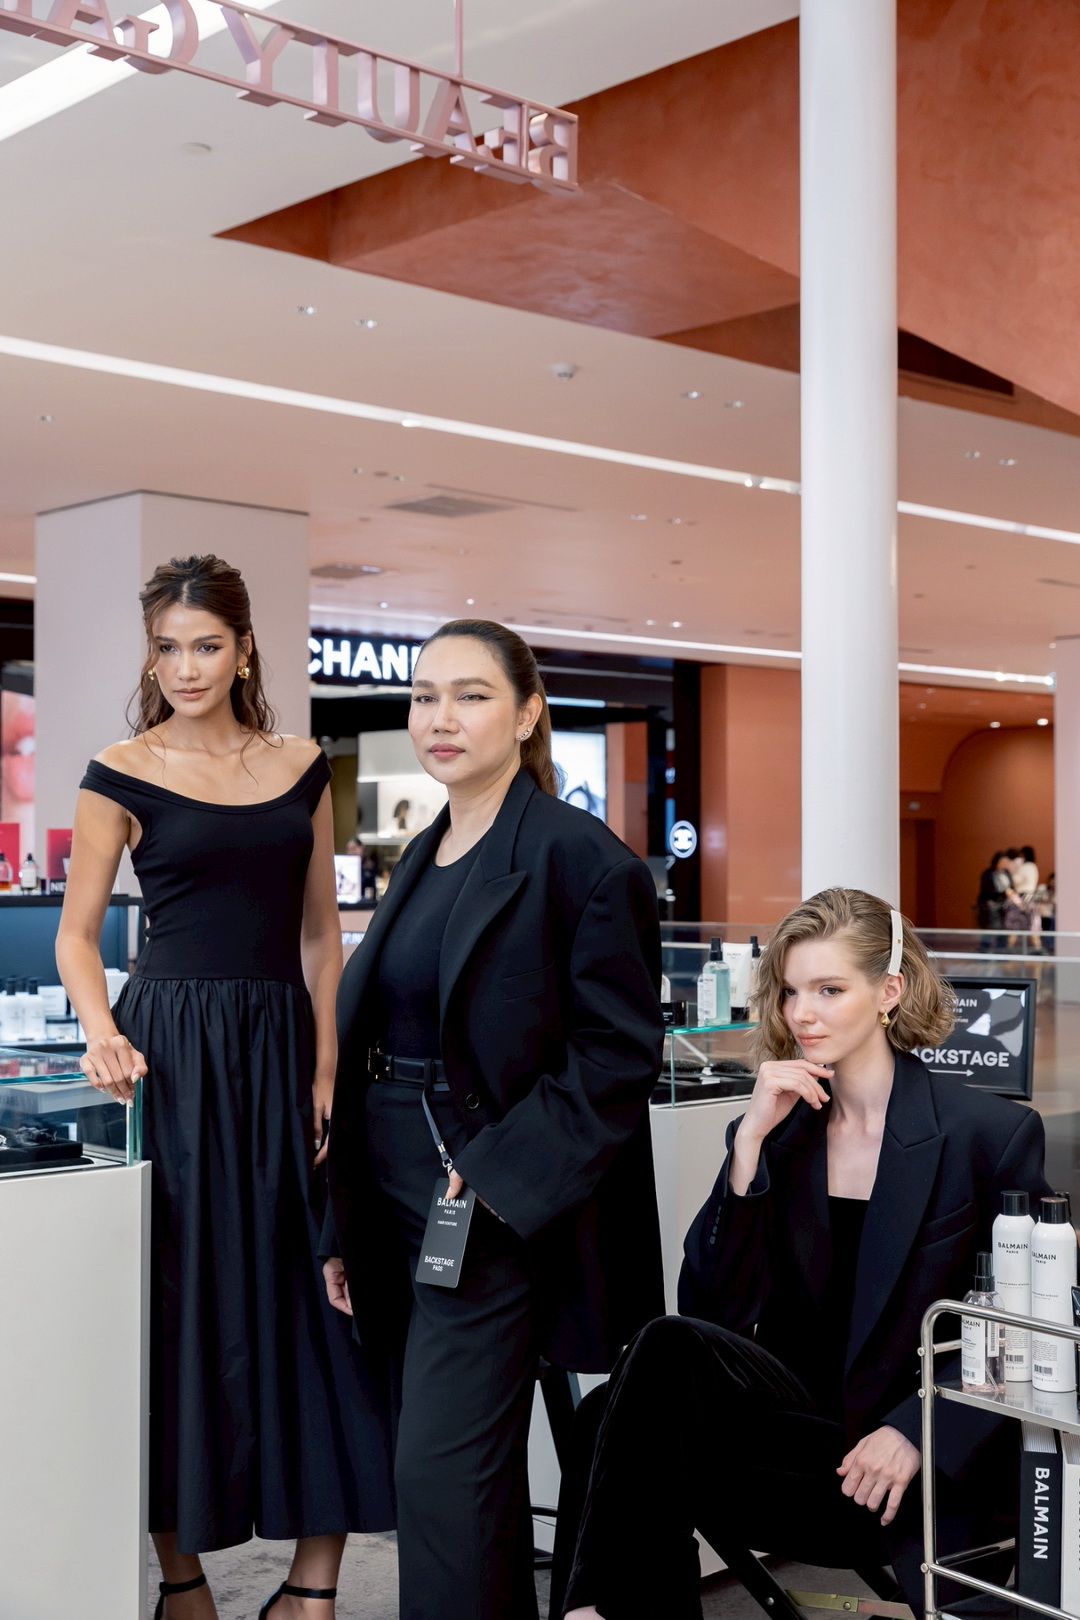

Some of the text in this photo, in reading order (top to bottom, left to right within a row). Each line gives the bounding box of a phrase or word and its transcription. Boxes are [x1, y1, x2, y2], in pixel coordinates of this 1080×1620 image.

[437, 1197, 467, 1209] BALMAIN
[424, 1255, 455, 1267] BACKSTAGE
[1033, 1467, 1050, 1560] BALMAIN
